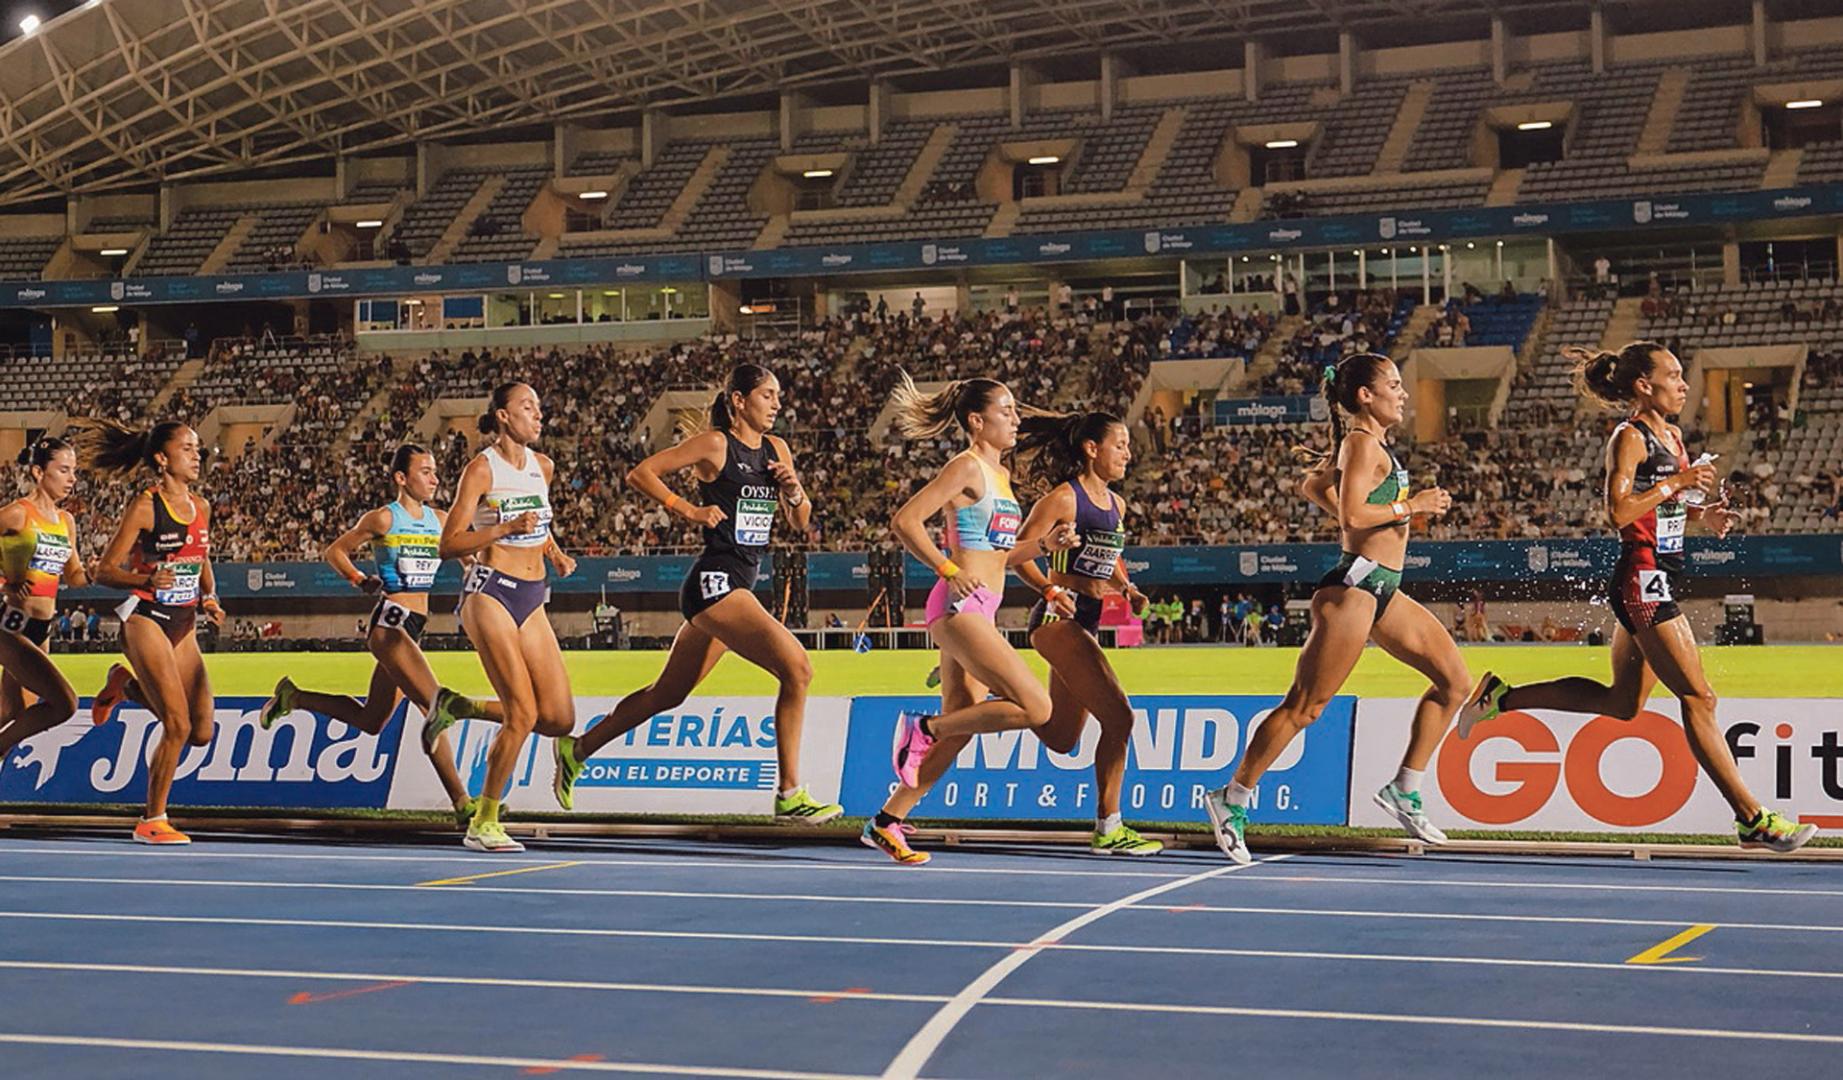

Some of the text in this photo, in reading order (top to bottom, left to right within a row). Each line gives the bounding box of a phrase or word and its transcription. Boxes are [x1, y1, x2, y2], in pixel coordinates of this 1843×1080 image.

[703, 574, 726, 594] 17
[384, 605, 404, 626] 8
[579, 766, 749, 782] CON EL DEPORTE
[1038, 783, 1058, 807] &
[1076, 783, 1300, 810] FOORNG.
